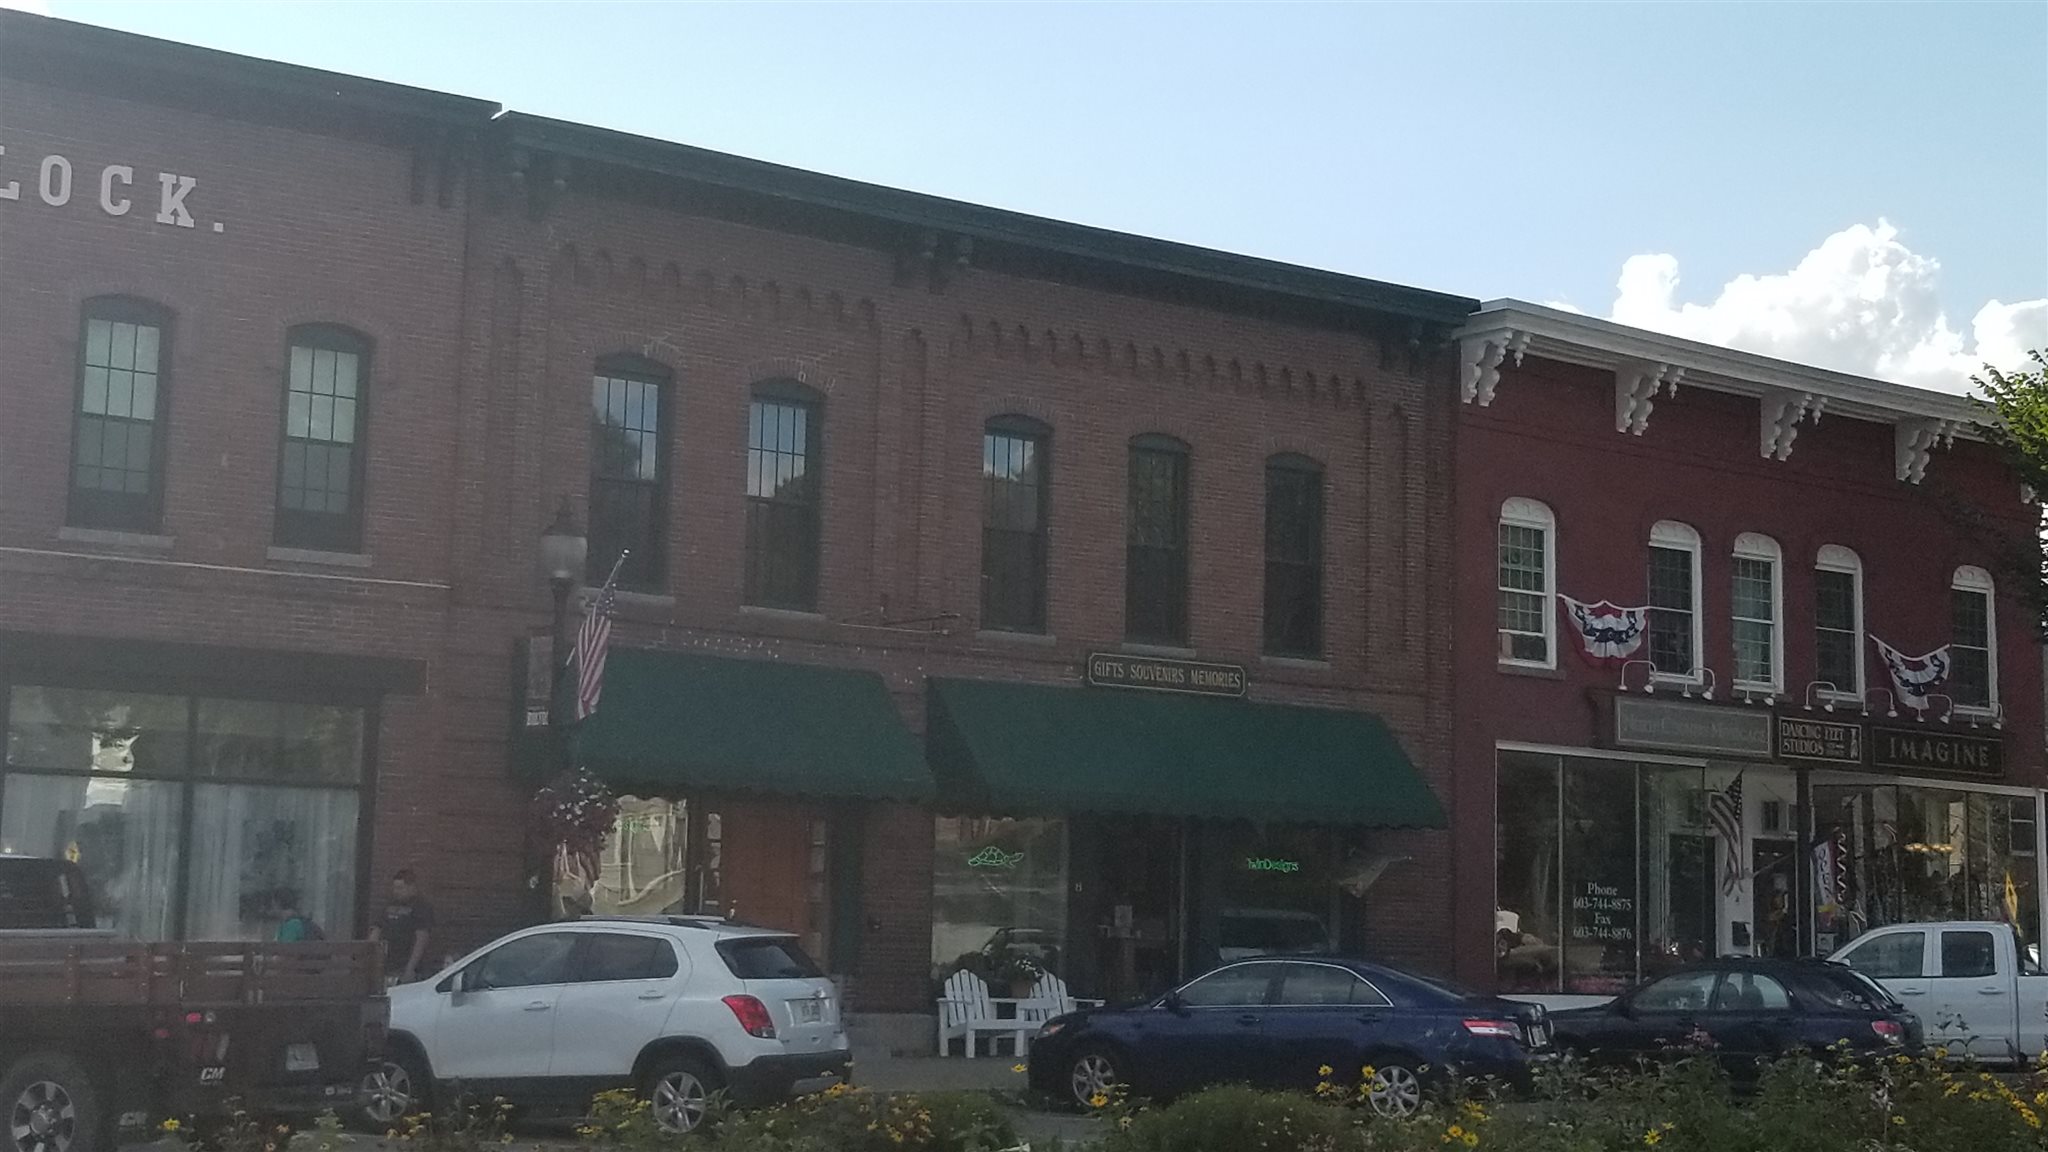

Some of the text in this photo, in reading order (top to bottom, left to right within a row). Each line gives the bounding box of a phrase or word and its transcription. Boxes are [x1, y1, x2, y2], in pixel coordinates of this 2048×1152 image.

[1094, 660, 1241, 688] GIFTS SOUVENIRS MEMORIES
[1782, 738, 1824, 756] STUDIOS
[1889, 737, 1989, 767] IMAGINE
[1587, 882, 1618, 896] Phone
[1594, 912, 1611, 925] Fax
[200, 1066, 226, 1081] CM
